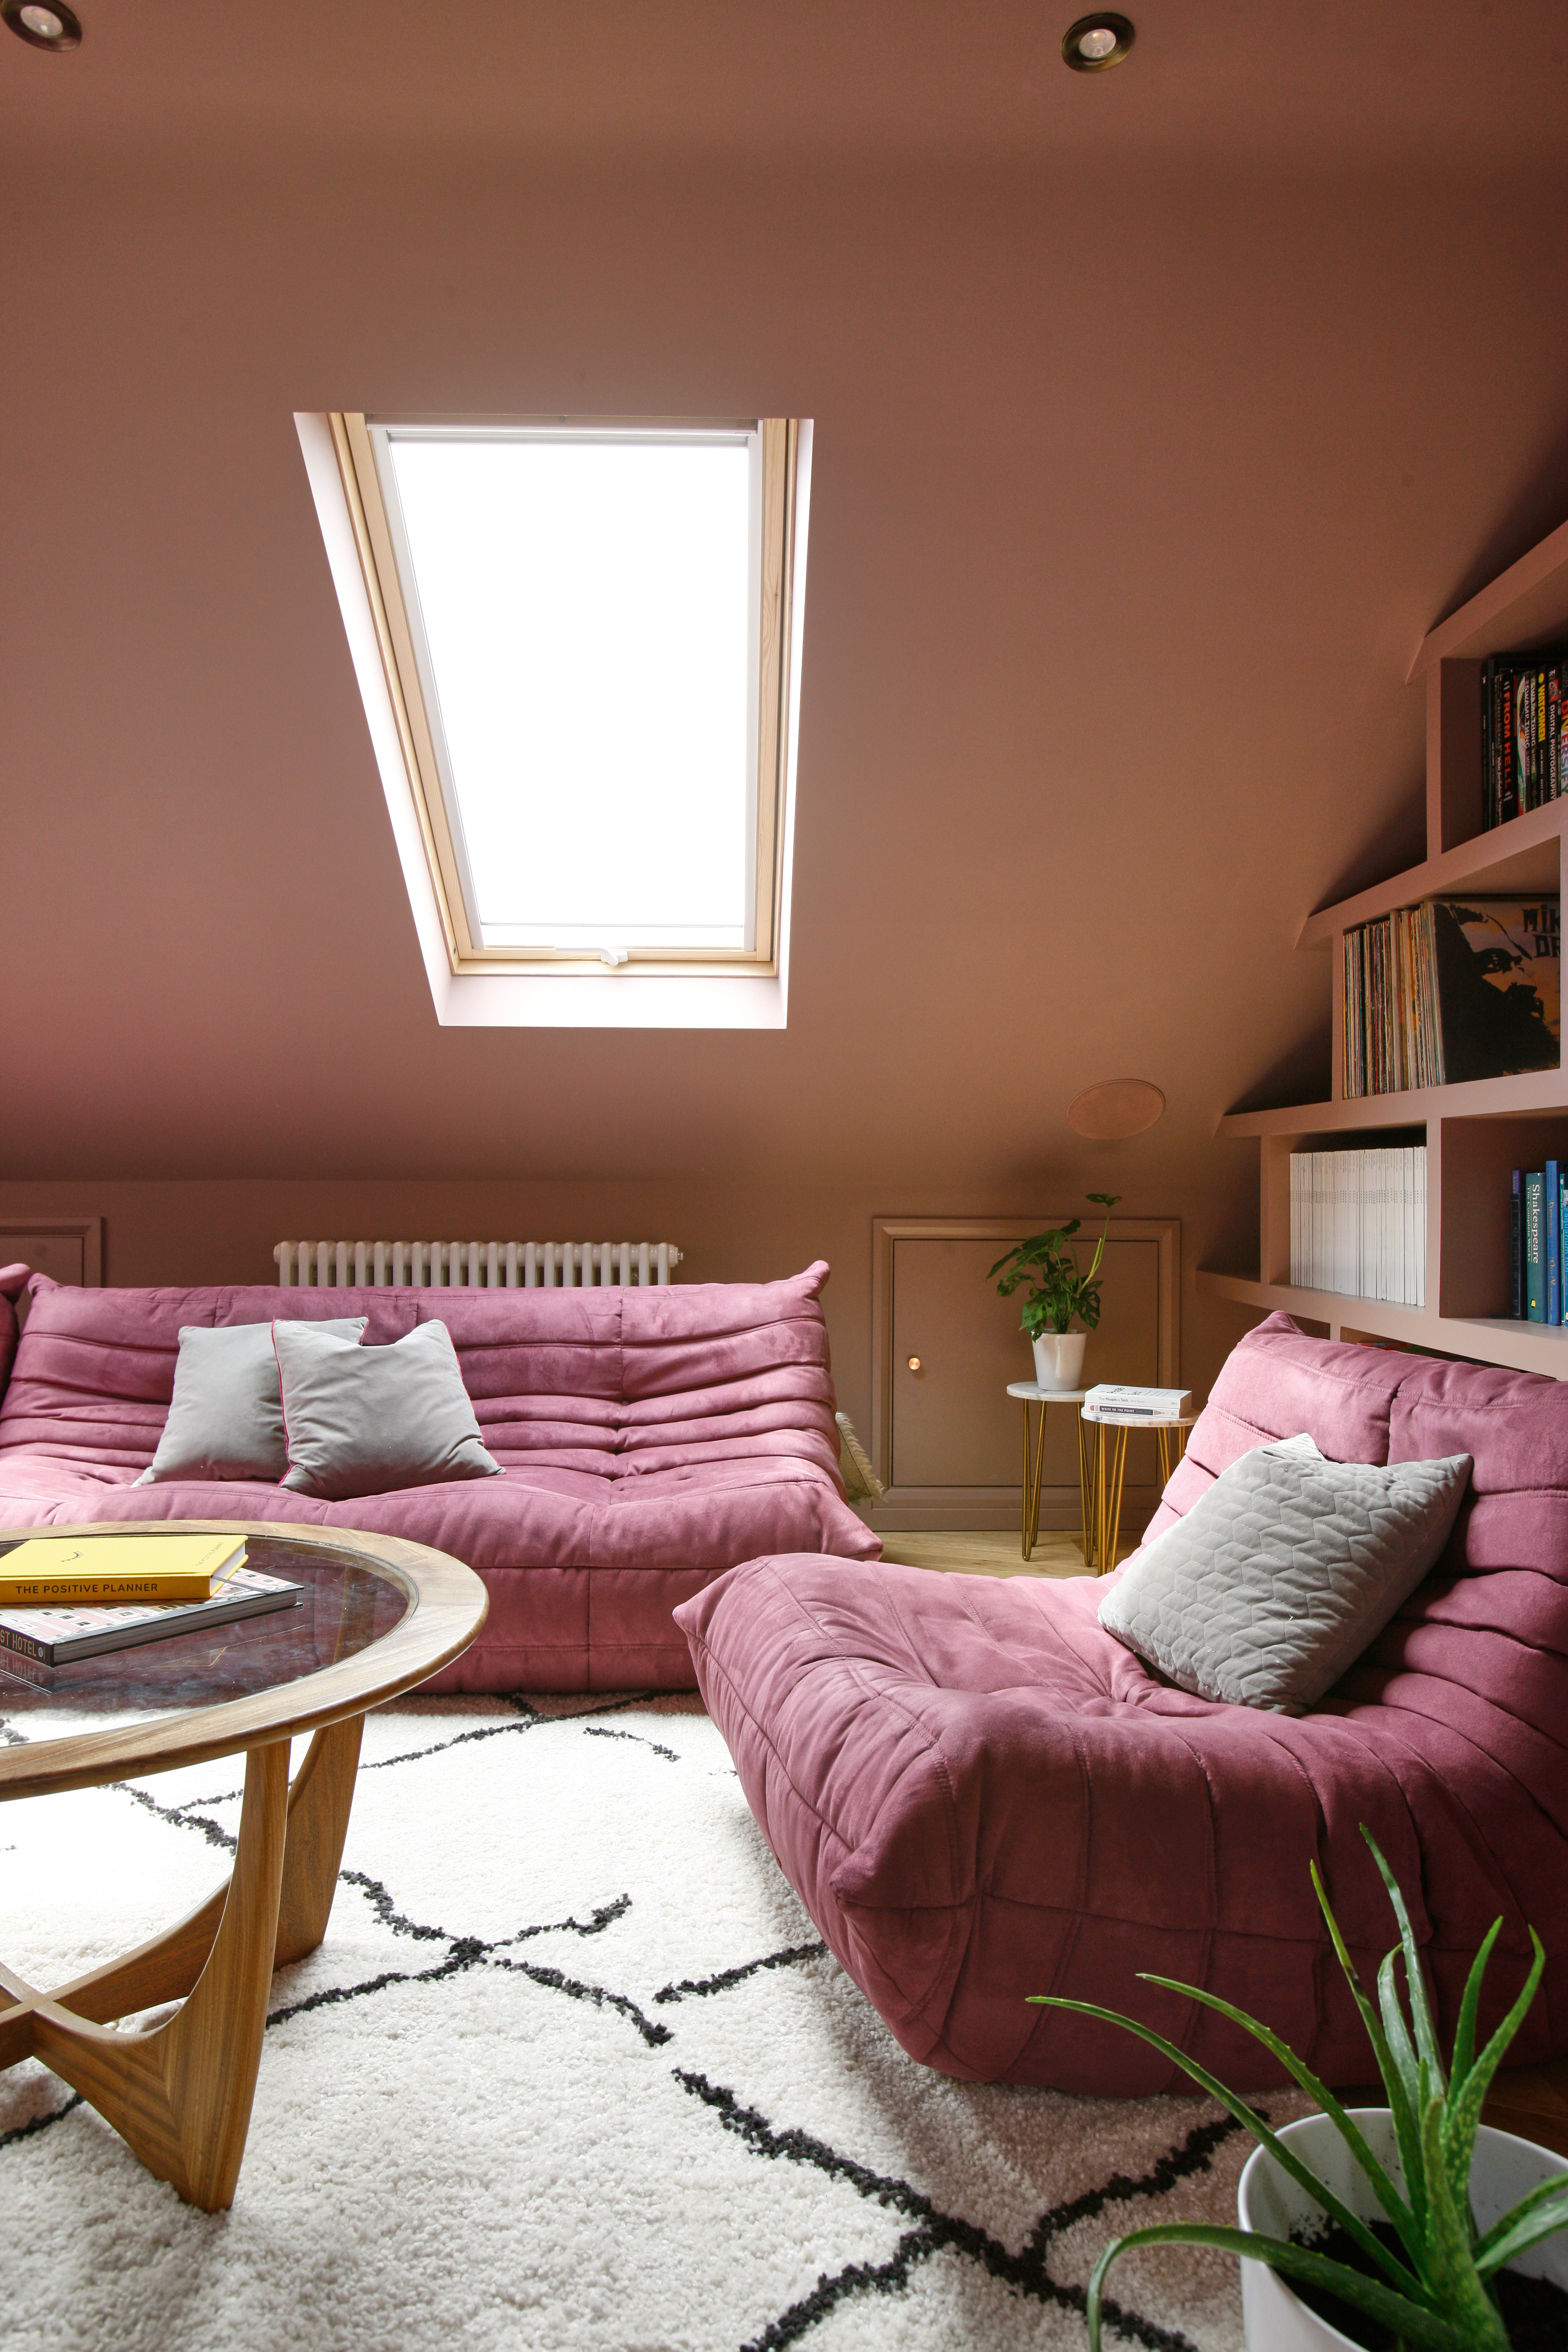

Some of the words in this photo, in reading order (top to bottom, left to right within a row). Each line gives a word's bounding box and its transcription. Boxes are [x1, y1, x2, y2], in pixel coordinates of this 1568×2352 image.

[1532, 1184, 1540, 1264] Shakespeare
[15, 1586, 39, 1594] THE
[44, 1584, 98, 1594] POSITIVE
[103, 1583, 158, 1592] PLANNER
[13, 1632, 37, 1657] HOTEL
